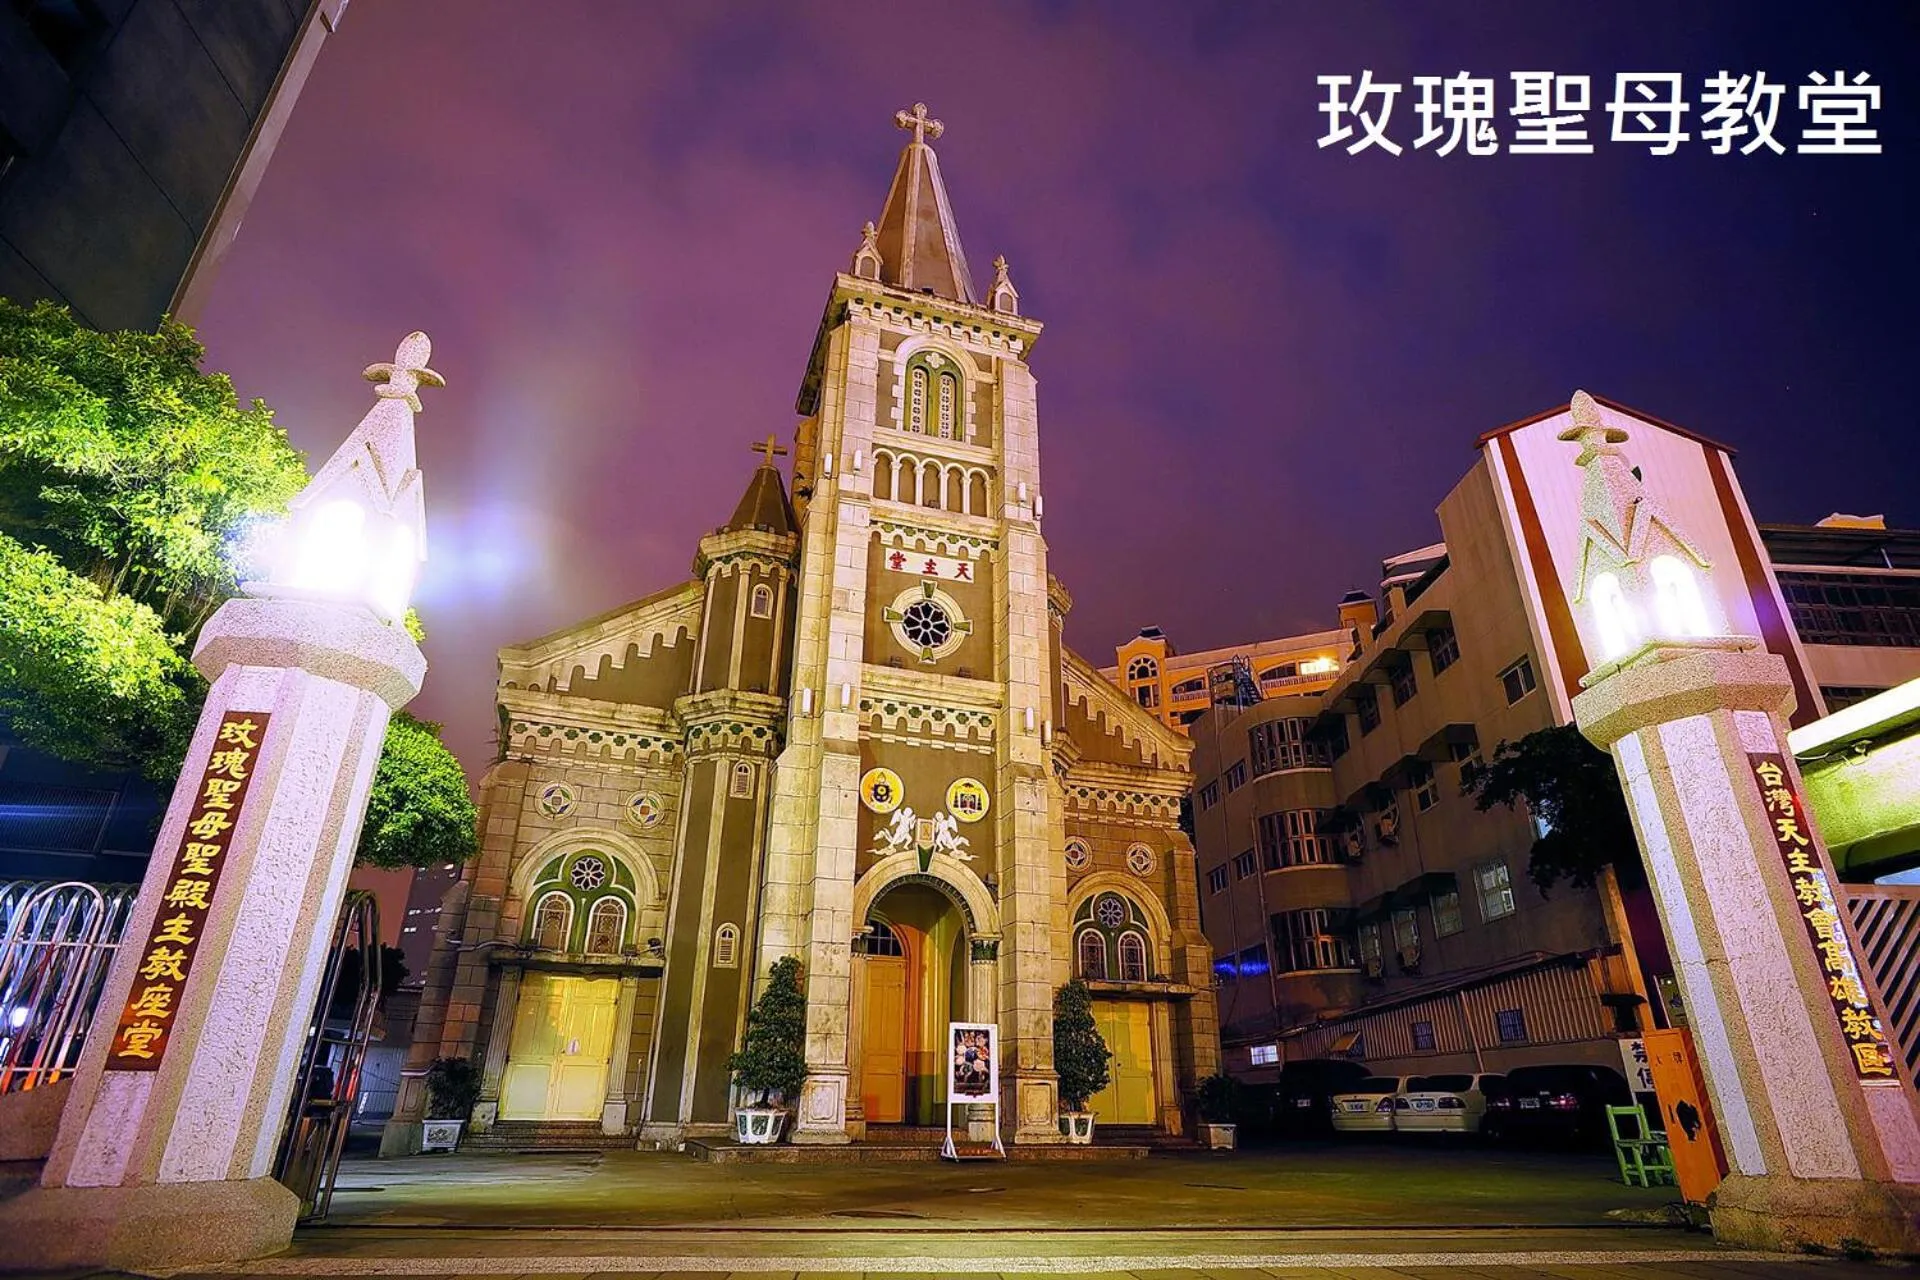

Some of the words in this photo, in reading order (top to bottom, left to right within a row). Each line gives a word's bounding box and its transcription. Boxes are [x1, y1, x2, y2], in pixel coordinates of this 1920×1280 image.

[889, 551, 972, 581] 天主堂
[118, 719, 259, 1060] 玫瑰聖母聖殿主教座堂
[1755, 761, 1893, 1076] 台灣天主教會高雄教區
